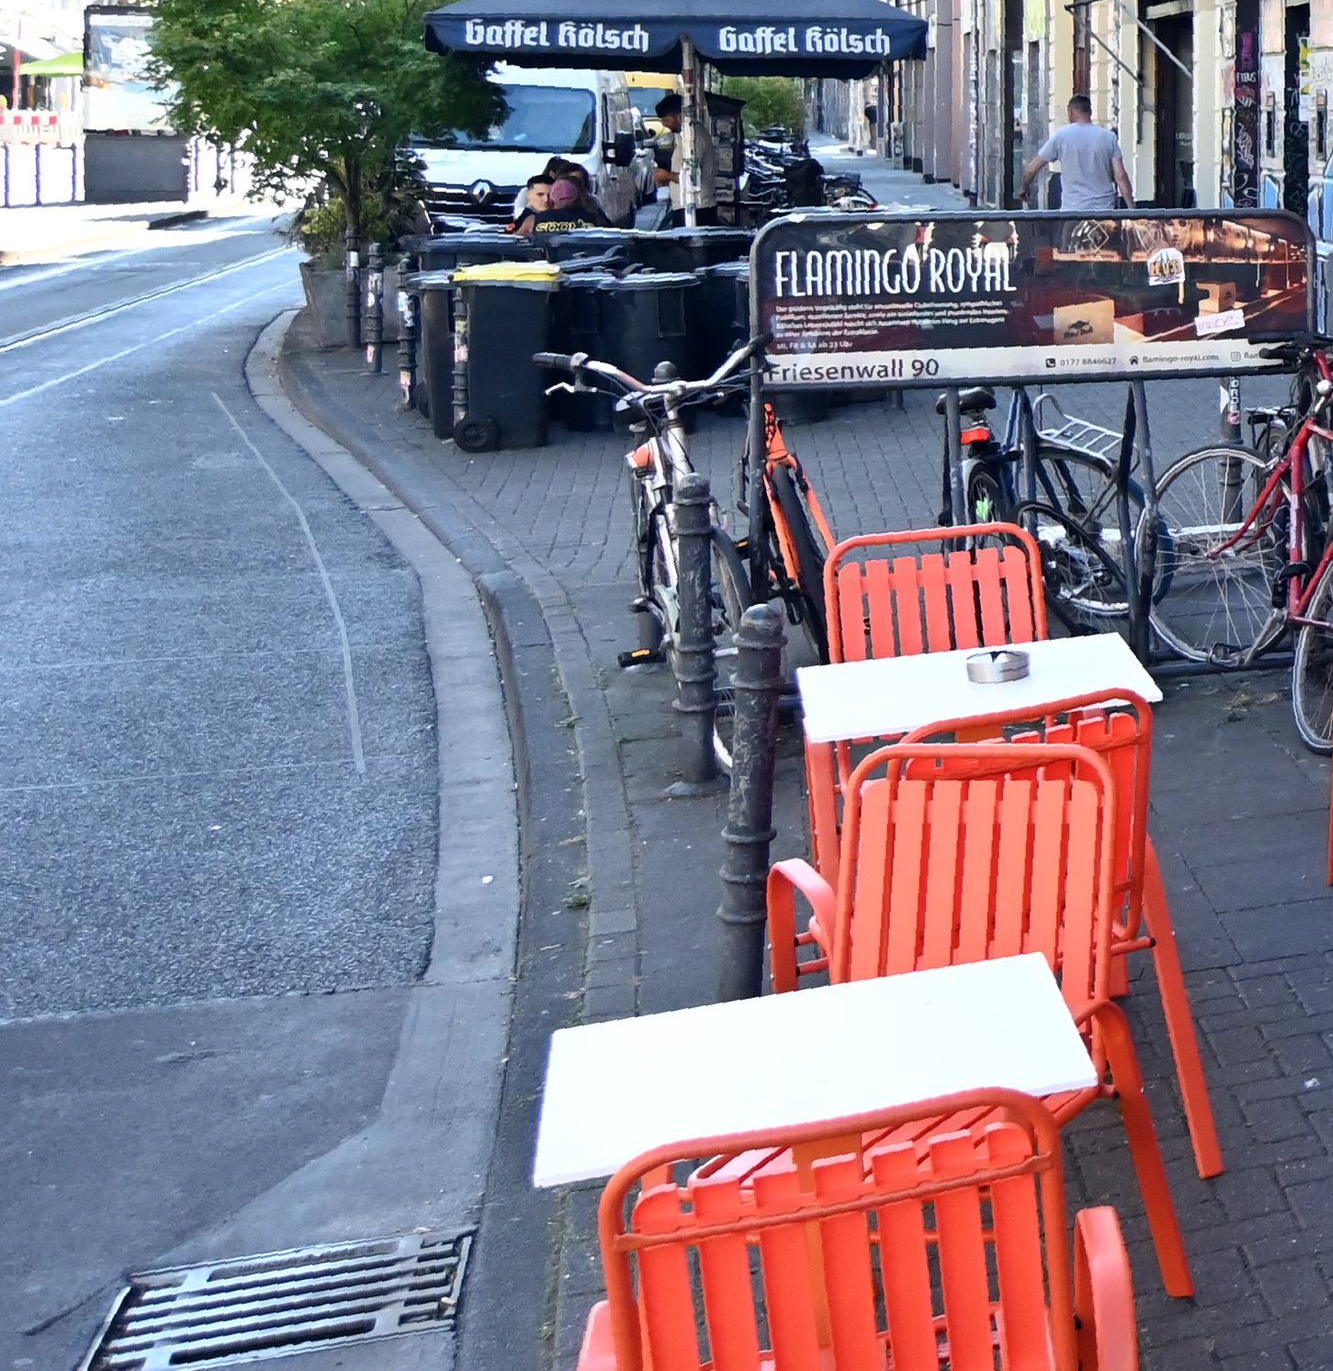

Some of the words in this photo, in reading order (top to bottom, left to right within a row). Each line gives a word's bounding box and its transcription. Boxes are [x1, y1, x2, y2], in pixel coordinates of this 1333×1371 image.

[465, 18, 551, 48] Gaffel
[558, 21, 649, 53] Kölsch
[719, 26, 798, 55] Gaffel
[805, 26, 891, 56] Kölsch
[775, 244, 921, 297] FLAMINGO
[930, 245, 1017, 293] ROYAL
[769, 359, 904, 381] Friesenwall
[911, 358, 939, 377] 90
[1059, 358, 1080, 367] 0177
